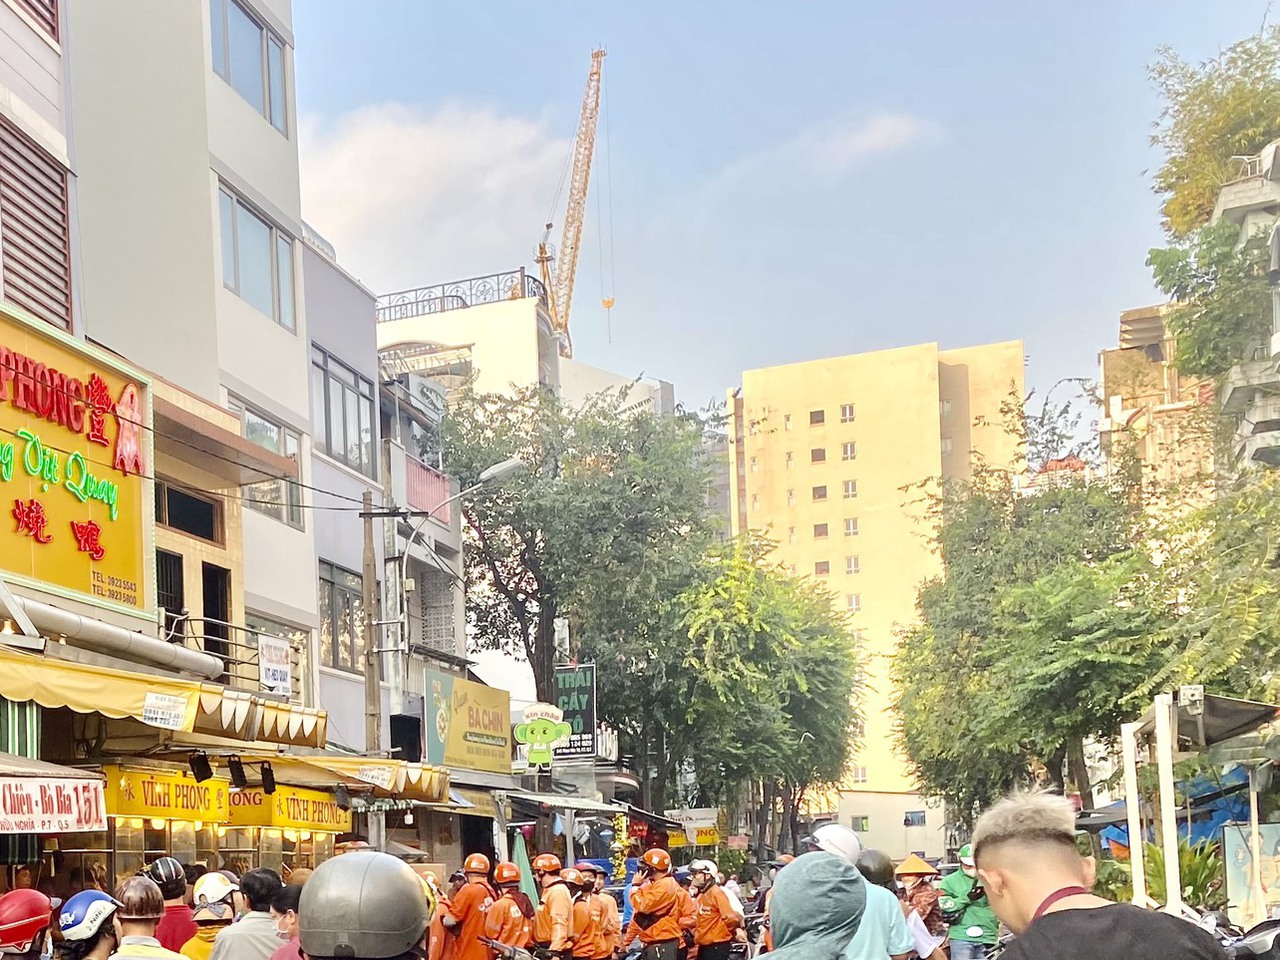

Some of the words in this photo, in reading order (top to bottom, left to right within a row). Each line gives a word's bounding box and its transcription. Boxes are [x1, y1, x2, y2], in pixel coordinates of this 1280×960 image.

[65, 451, 119, 522] Quay
[107, 575, 122, 589] 3923
[122, 579, 137, 593] 5543
[107, 588, 122, 602] 3923
[556, 669, 592, 688] TRÁI
[2, 783, 34, 816] Chiên
[73, 783, 105, 829] 151
[174, 783, 210, 811] PHONG
[312, 799, 341, 825] PHONG
[41, 820, 52, 830] P.7
[58, 819, 70, 832] Q.5
